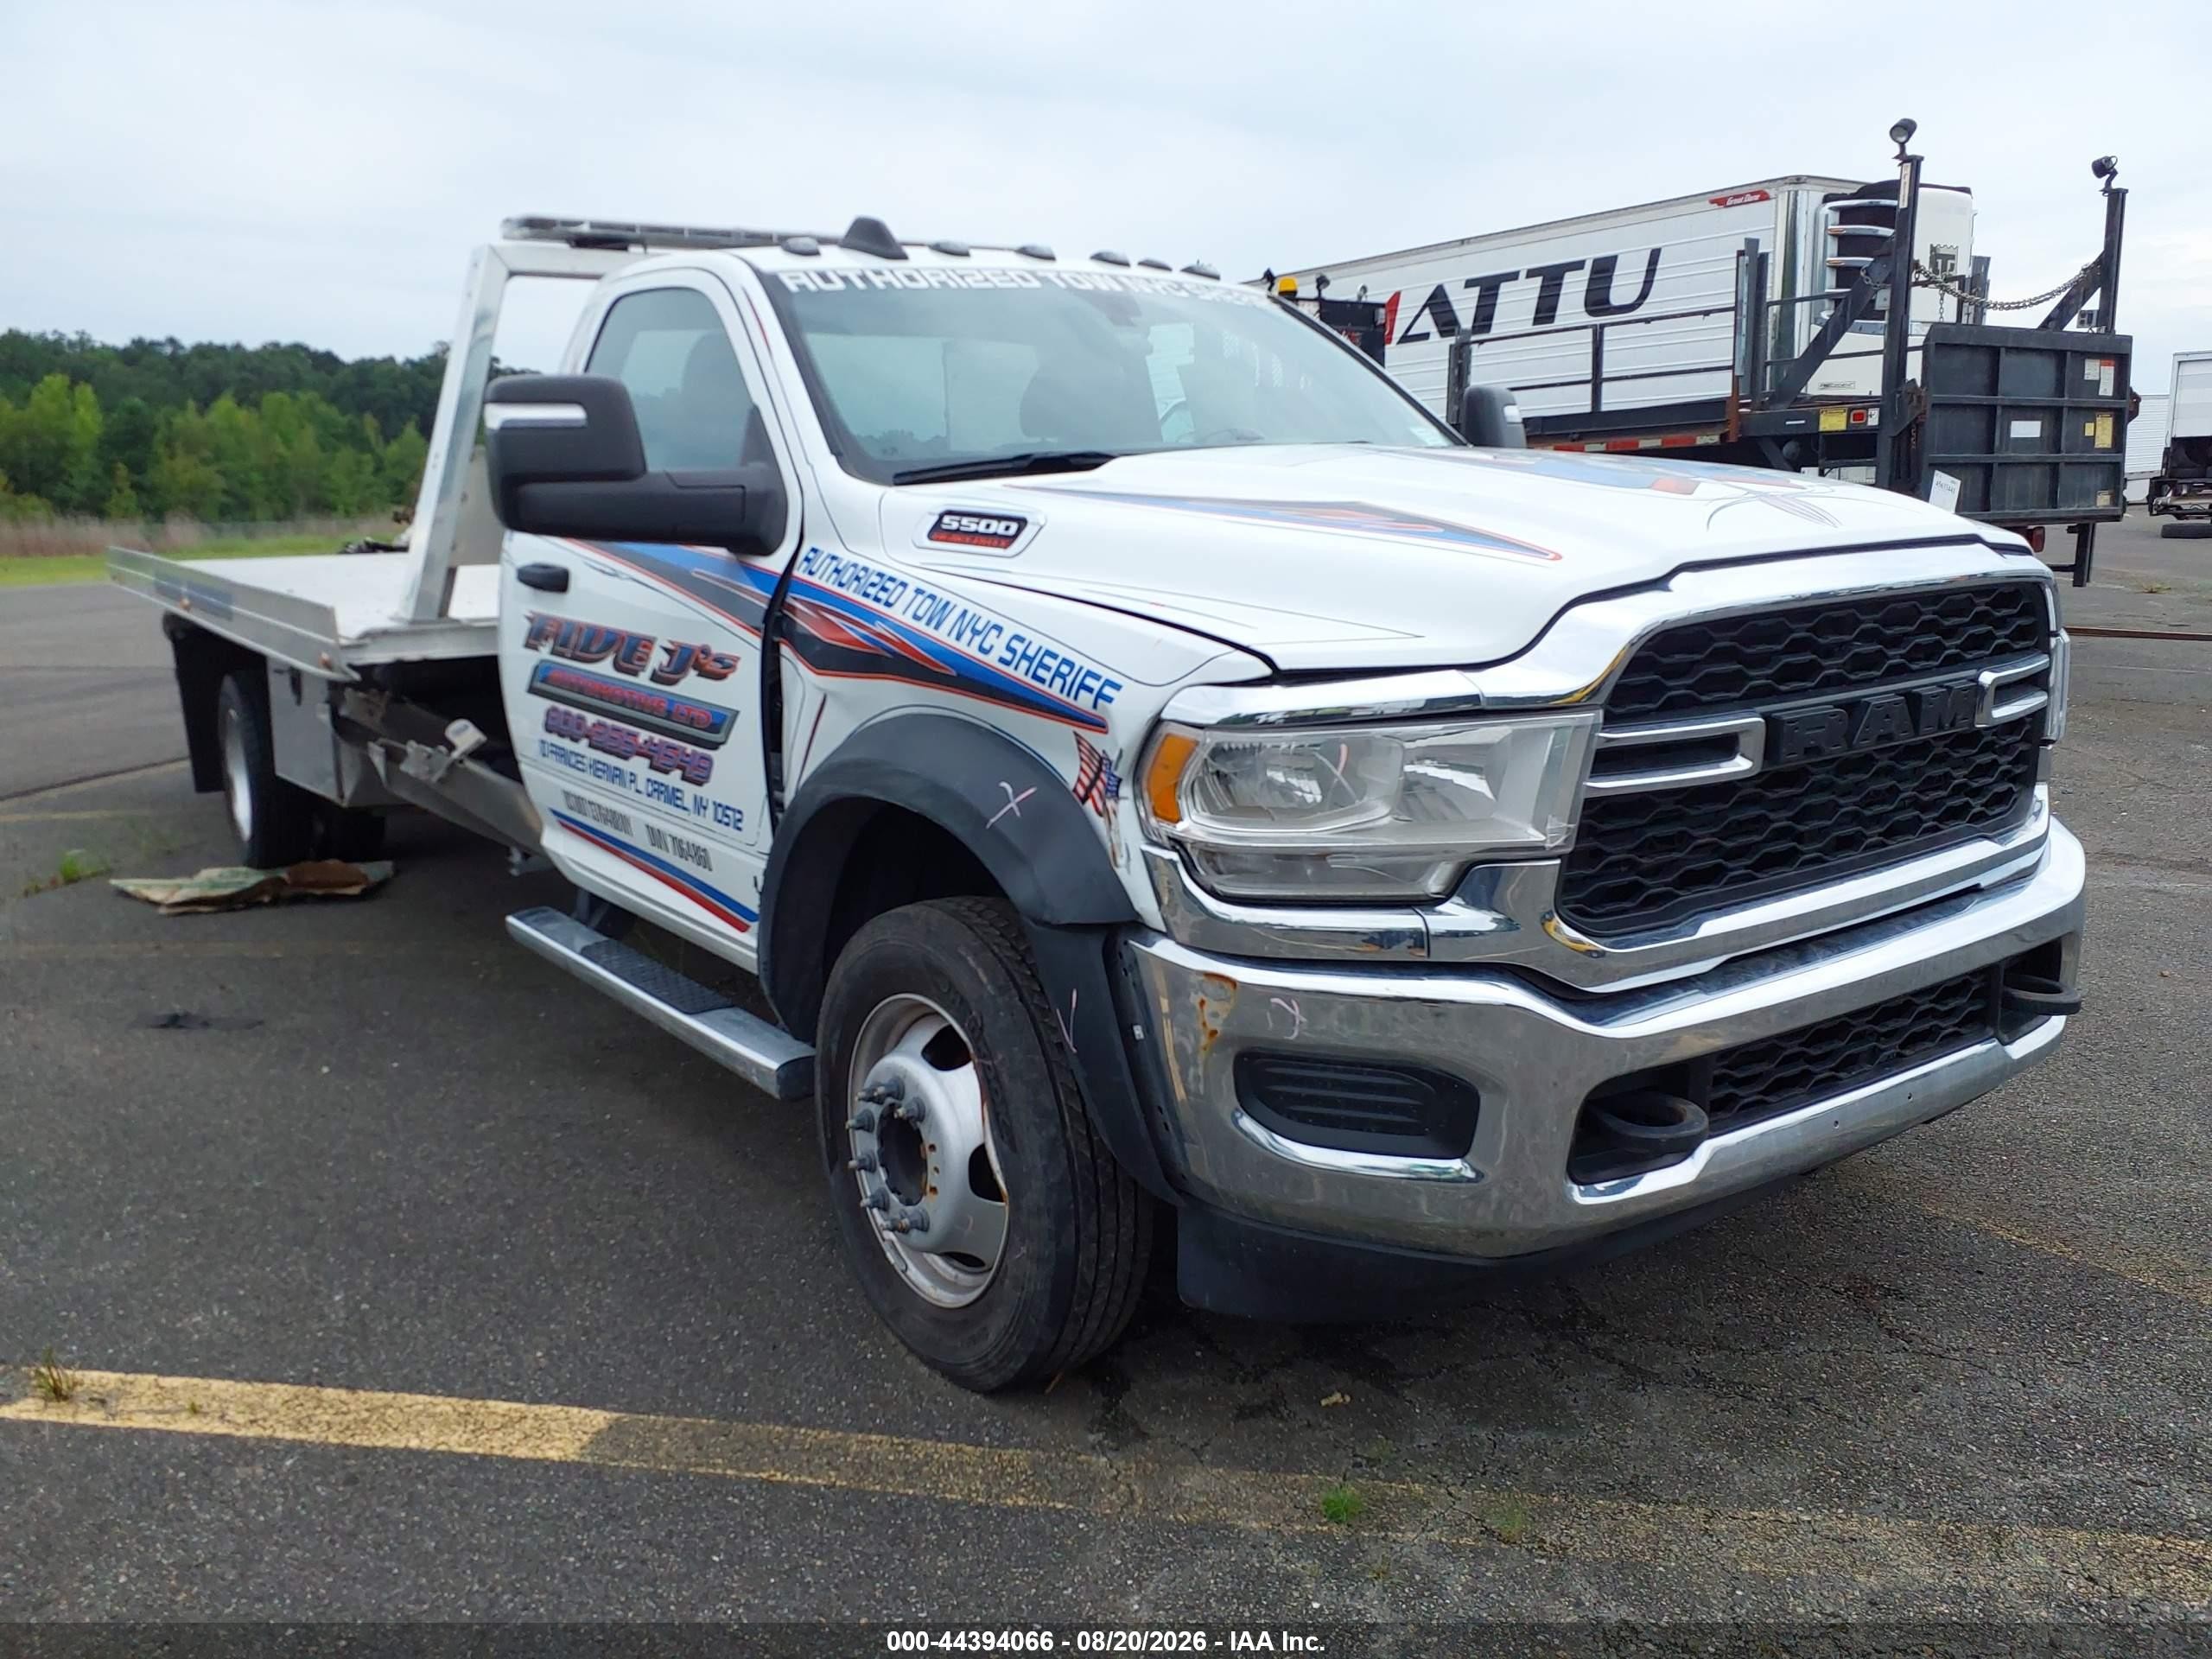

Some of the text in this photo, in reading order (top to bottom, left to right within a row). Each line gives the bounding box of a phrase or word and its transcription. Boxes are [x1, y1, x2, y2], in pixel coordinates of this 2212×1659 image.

[780, 269, 1041, 293] AUTHORIZED
[1037, 270, 1122, 292] TOW
[940, 515, 1020, 537] 5500
[524, 610, 658, 677] FIVE
[798, 547, 1122, 710] AUTHORIZED TOW NYC SHERIFF
[1772, 679, 1978, 760] RAM
[692, 792, 709, 820] NY
[712, 800, 745, 832] 10512
